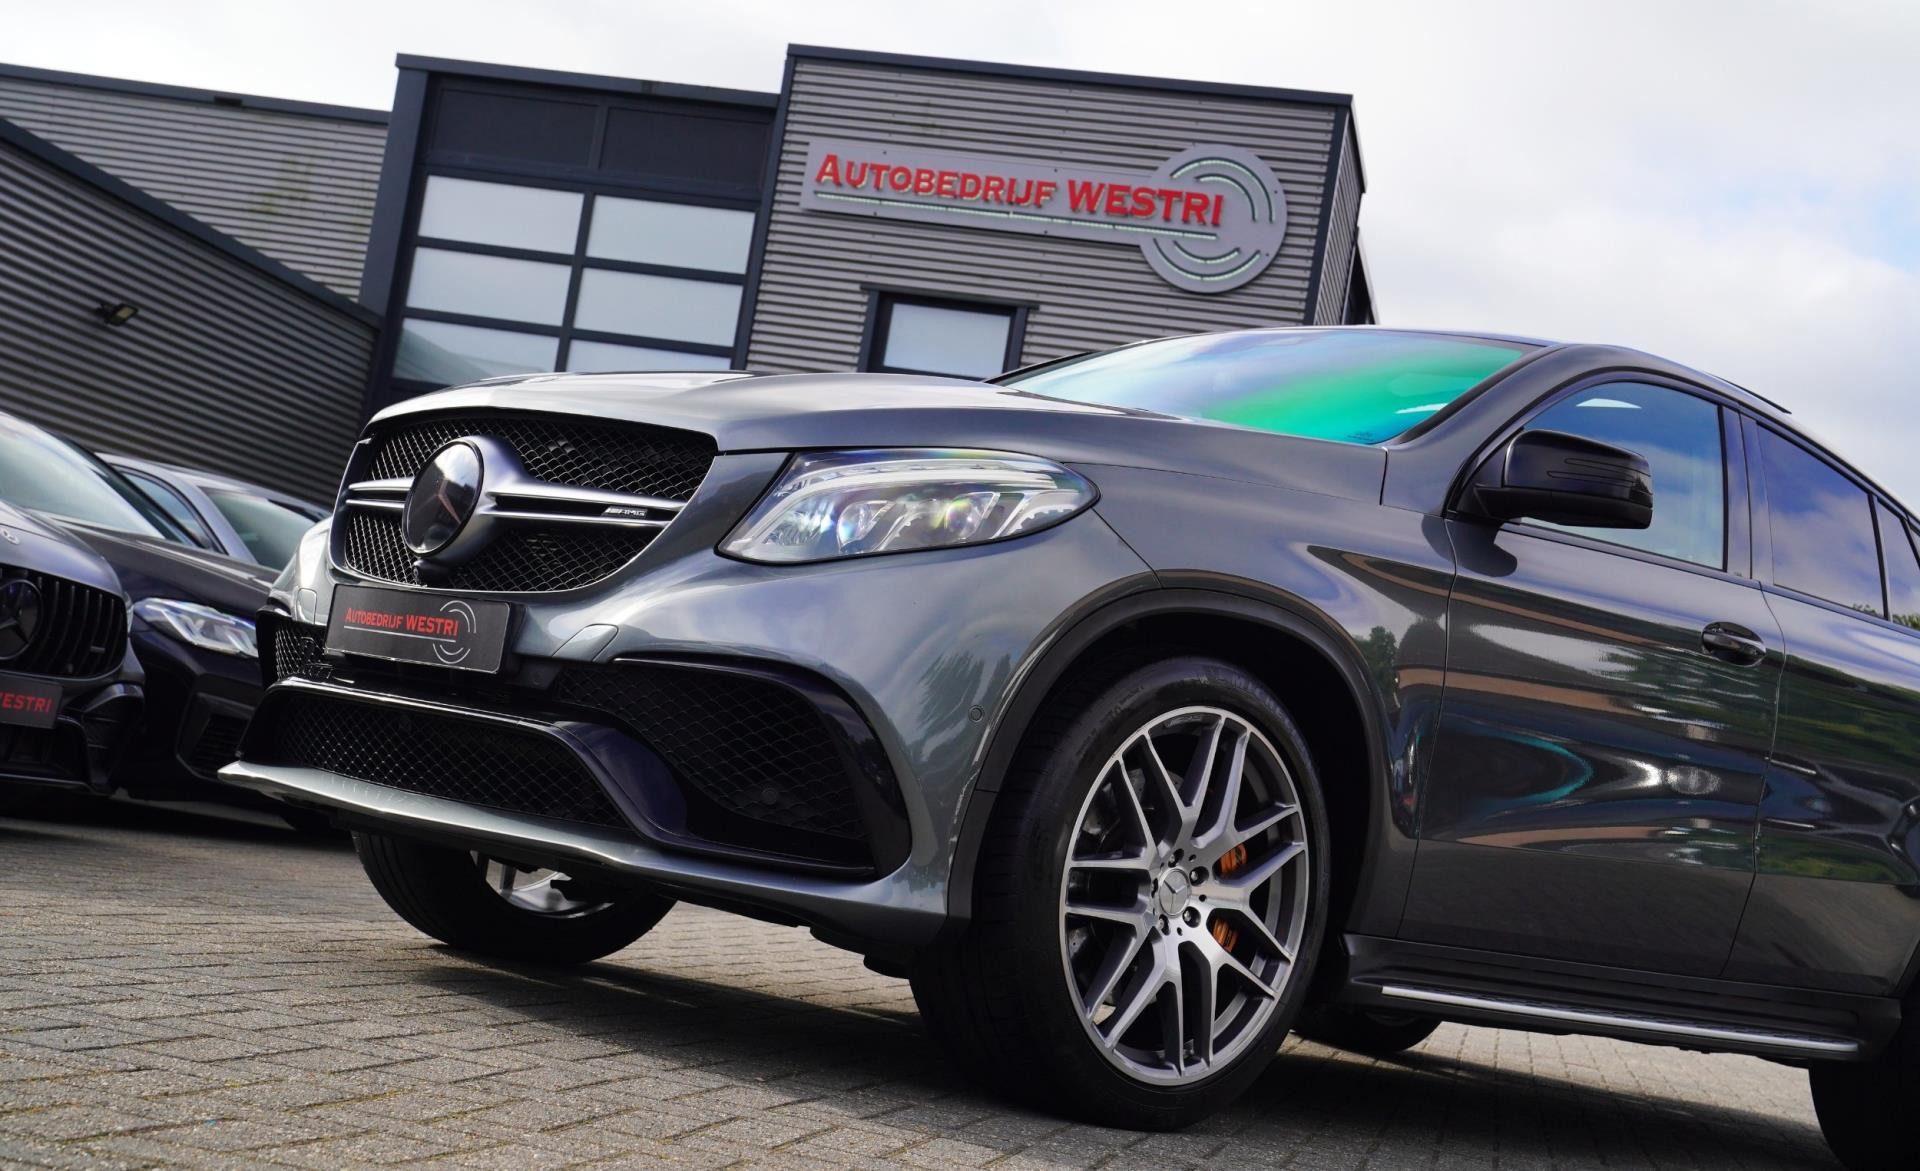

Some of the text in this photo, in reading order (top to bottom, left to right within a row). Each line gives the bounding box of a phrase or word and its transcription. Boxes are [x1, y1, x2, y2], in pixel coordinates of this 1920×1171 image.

[815, 153, 1224, 227] AUTOBEDRIJF WESTRI
[344, 607, 459, 636] AUTOBEDRIJF WESTRI
[0, 691, 53, 714] ESTRI
